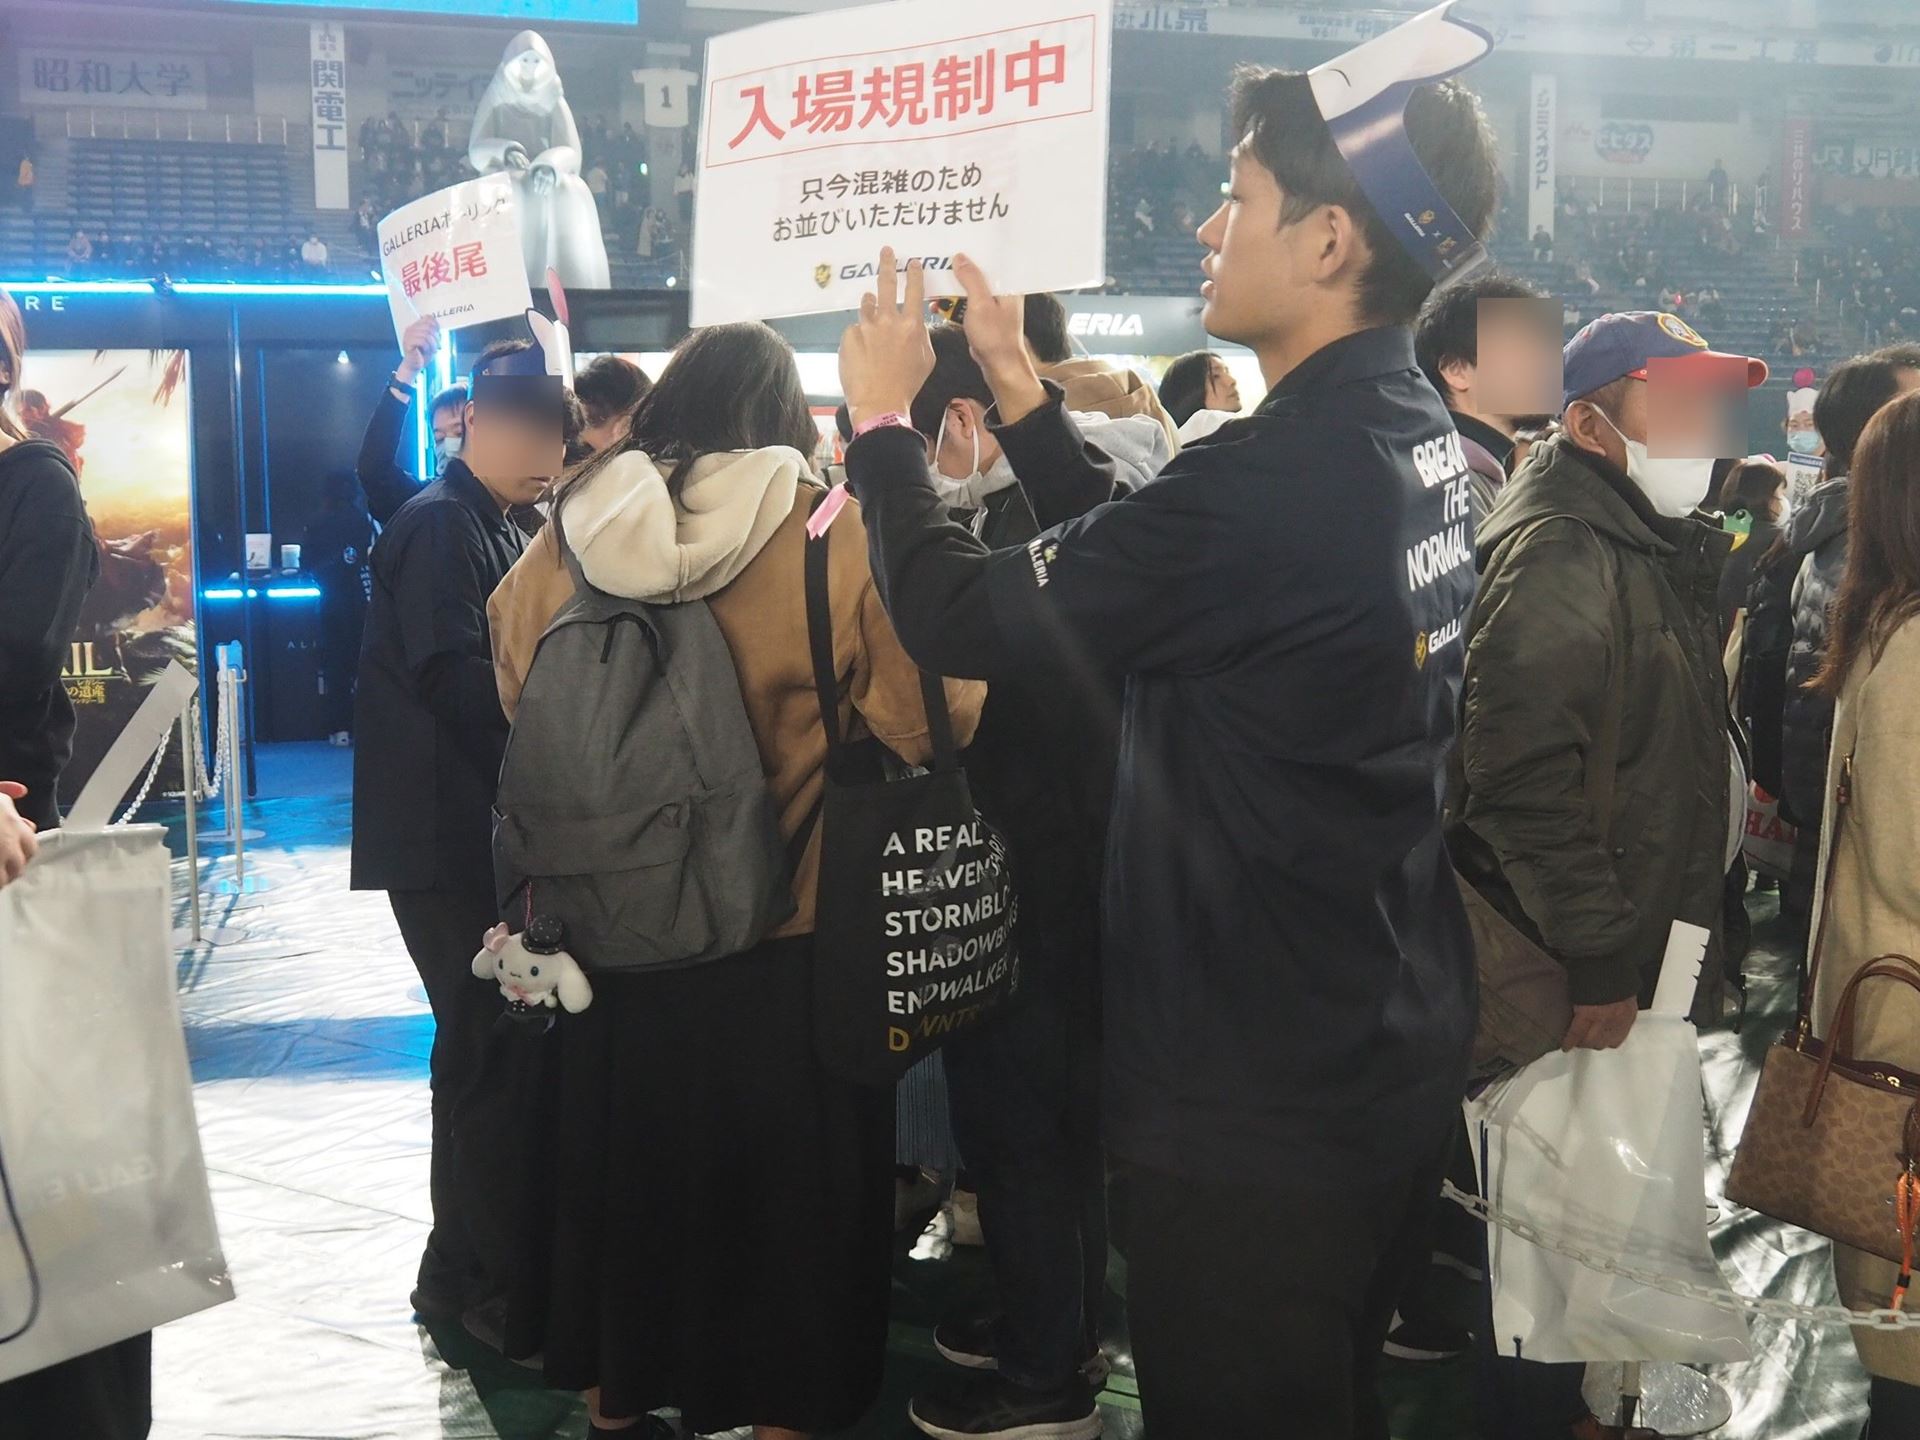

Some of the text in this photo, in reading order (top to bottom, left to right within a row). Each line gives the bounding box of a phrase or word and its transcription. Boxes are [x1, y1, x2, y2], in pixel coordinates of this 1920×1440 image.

[33, 57, 192, 96] 昭和大学
[660, 84, 672, 108] 1
[729, 39, 1066, 150] 入場規制中
[313, 60, 346, 150] 関電工
[801, 162, 982, 202] 只今混雑のため
[1791, 129, 1804, 231] 三井のリハウス
[773, 191, 1009, 243] お並びいただけません
[400, 241, 488, 298] 最後尾
[1412, 430, 1469, 488] BREAK
[1444, 474, 1470, 523] THE
[1406, 521, 1471, 592] NORMAL
[61, 642, 112, 676] IL
[882, 831, 906, 857] A
